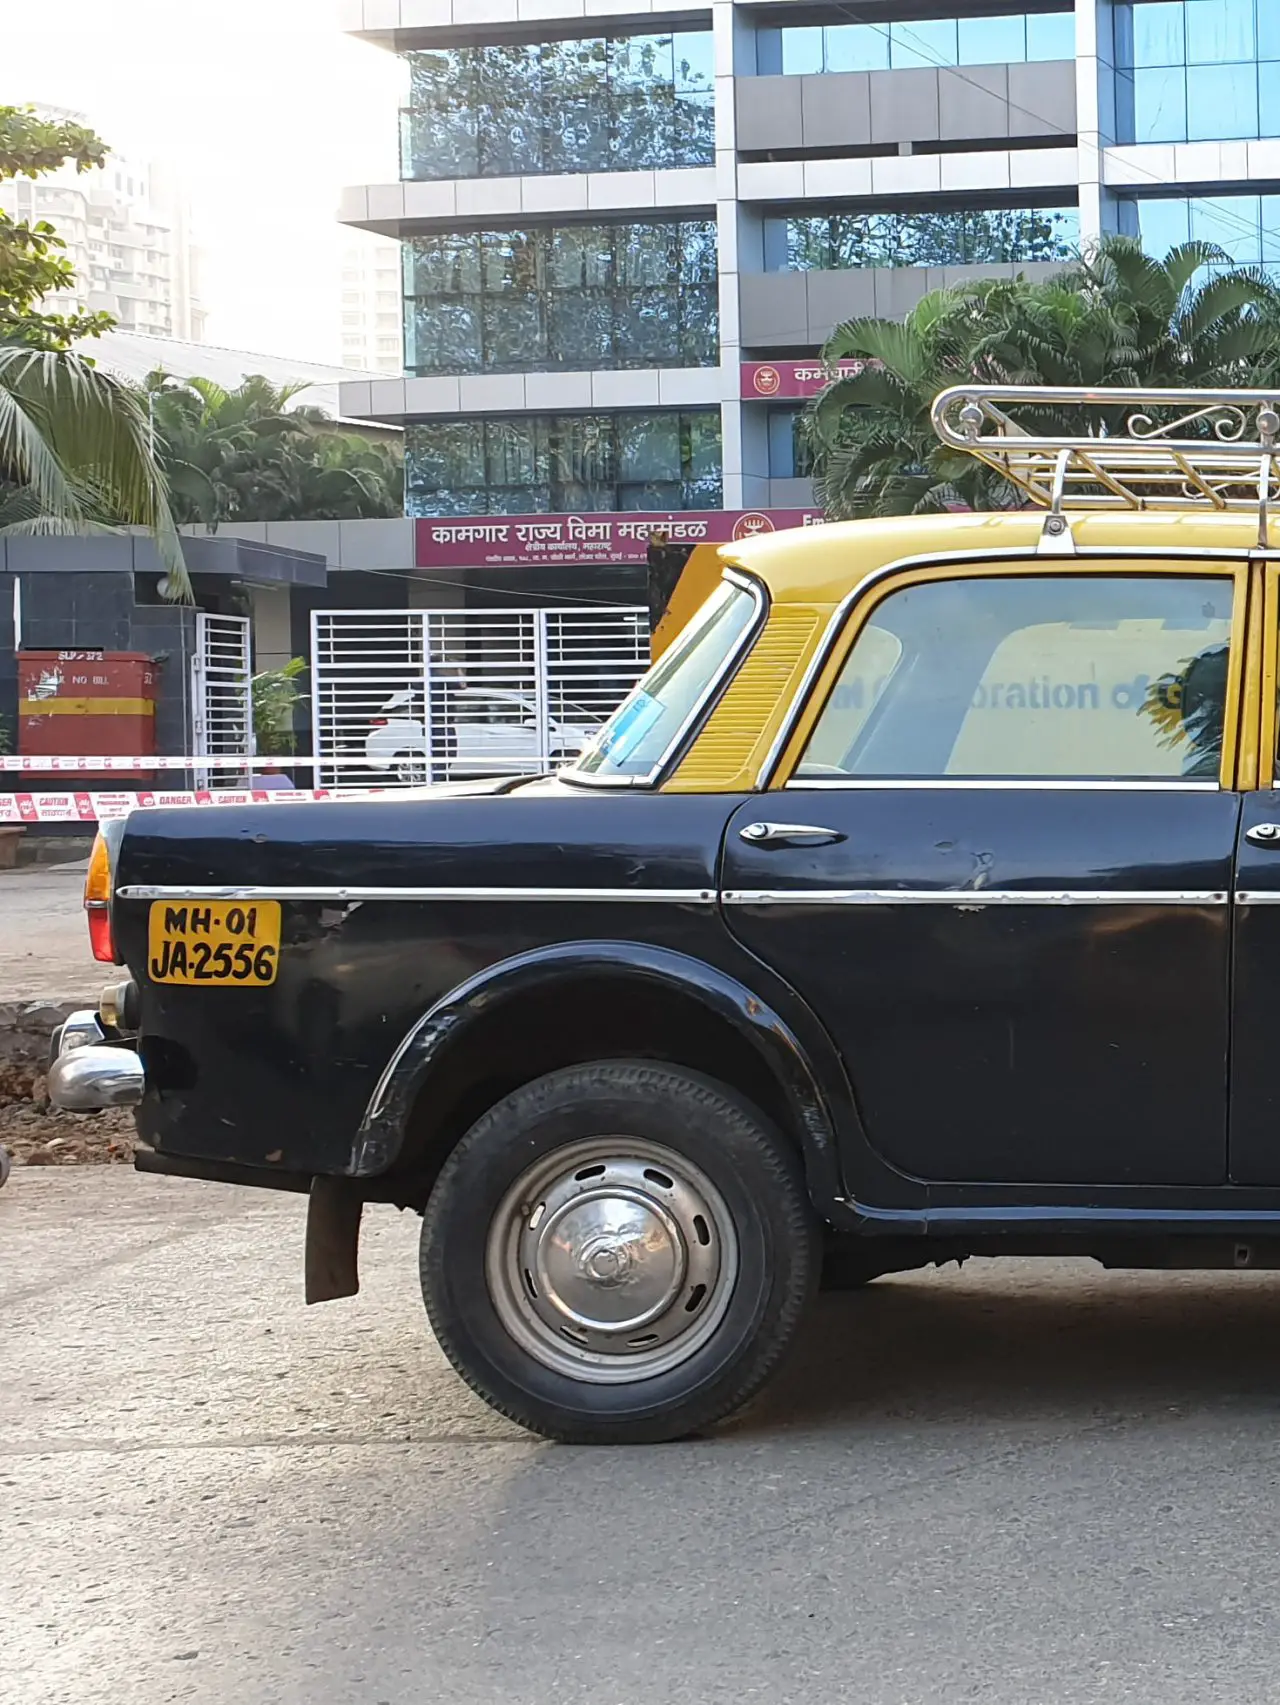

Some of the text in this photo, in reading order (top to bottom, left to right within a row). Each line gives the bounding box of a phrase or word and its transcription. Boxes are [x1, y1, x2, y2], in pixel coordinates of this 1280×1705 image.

[432, 515, 708, 544] कामगार राज्य विमा महामंडळ
[72, 676, 87, 684] NO
[970, 675, 1100, 709] oration
[1111, 674, 1150, 709] of
[159, 796, 192, 805] DANGER
